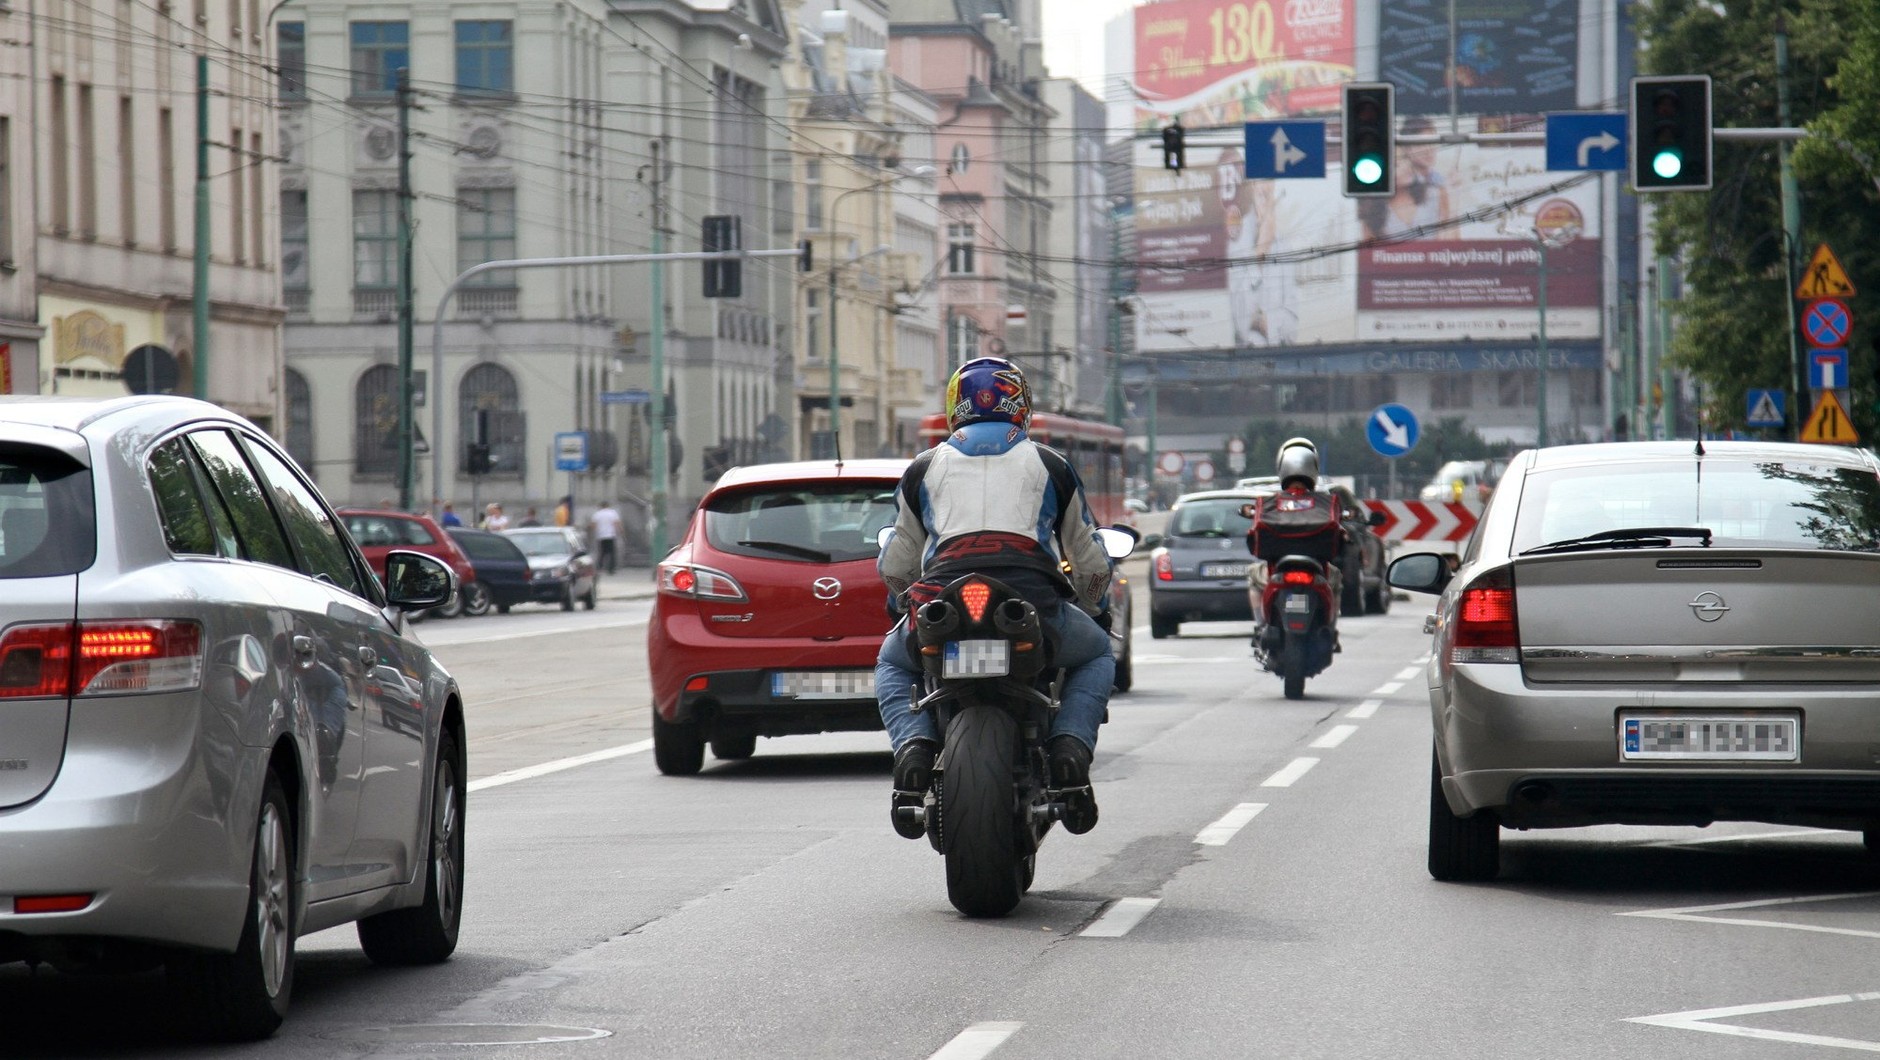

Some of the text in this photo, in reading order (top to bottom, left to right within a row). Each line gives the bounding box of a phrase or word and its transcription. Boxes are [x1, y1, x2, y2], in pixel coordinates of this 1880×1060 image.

[1208, 0, 1275, 66] 130
[1371, 248, 1426, 264] Finanse
[1367, 350, 1464, 372] GALERIA
